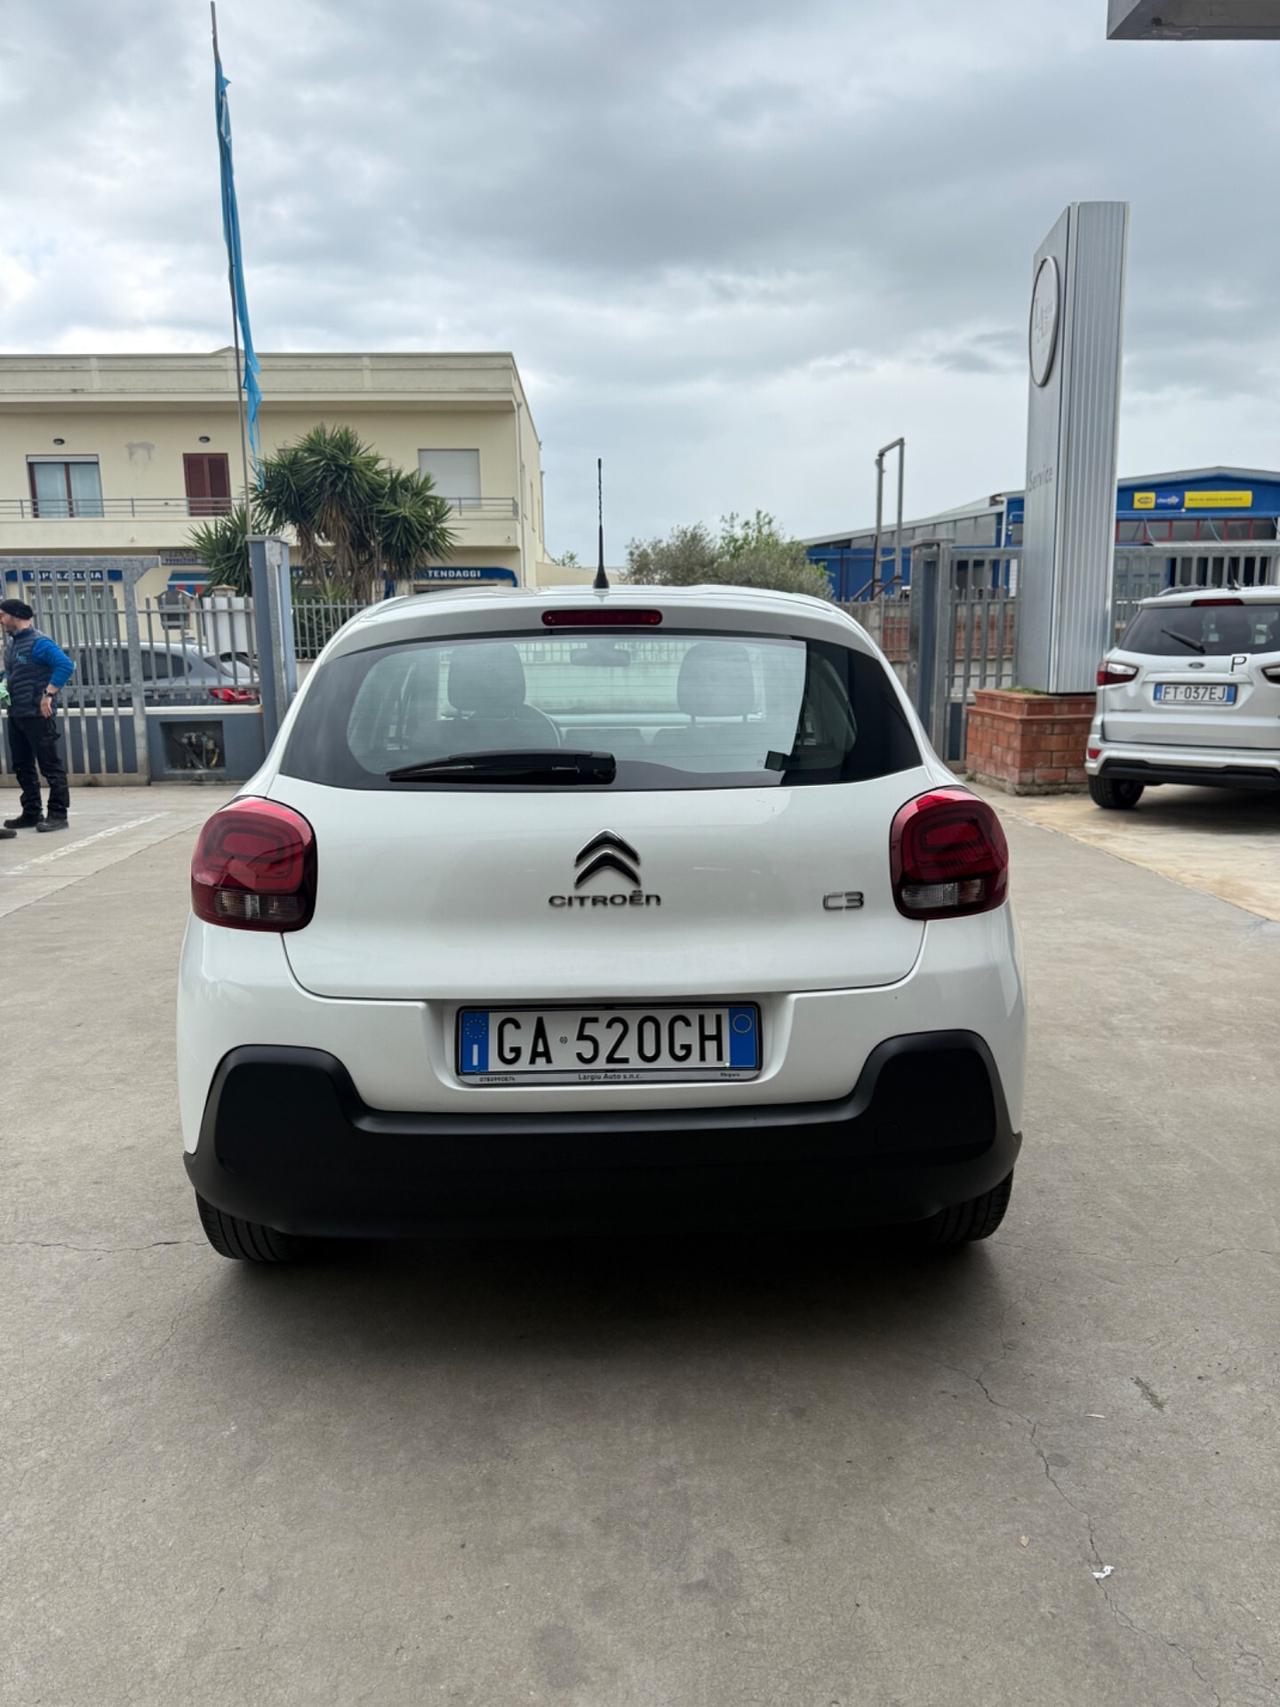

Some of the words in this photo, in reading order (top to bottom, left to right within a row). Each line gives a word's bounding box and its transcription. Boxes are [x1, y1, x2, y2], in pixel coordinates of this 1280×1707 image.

[427, 569, 481, 578] TENDAGGI
[1231, 656, 1247, 672] P
[1163, 686, 1180, 700] FT
[1184, 686, 1225, 701] 037EJ
[822, 891, 864, 911] C3
[496, 1016, 553, 1065] GA
[575, 1014, 724, 1064] 520GH
